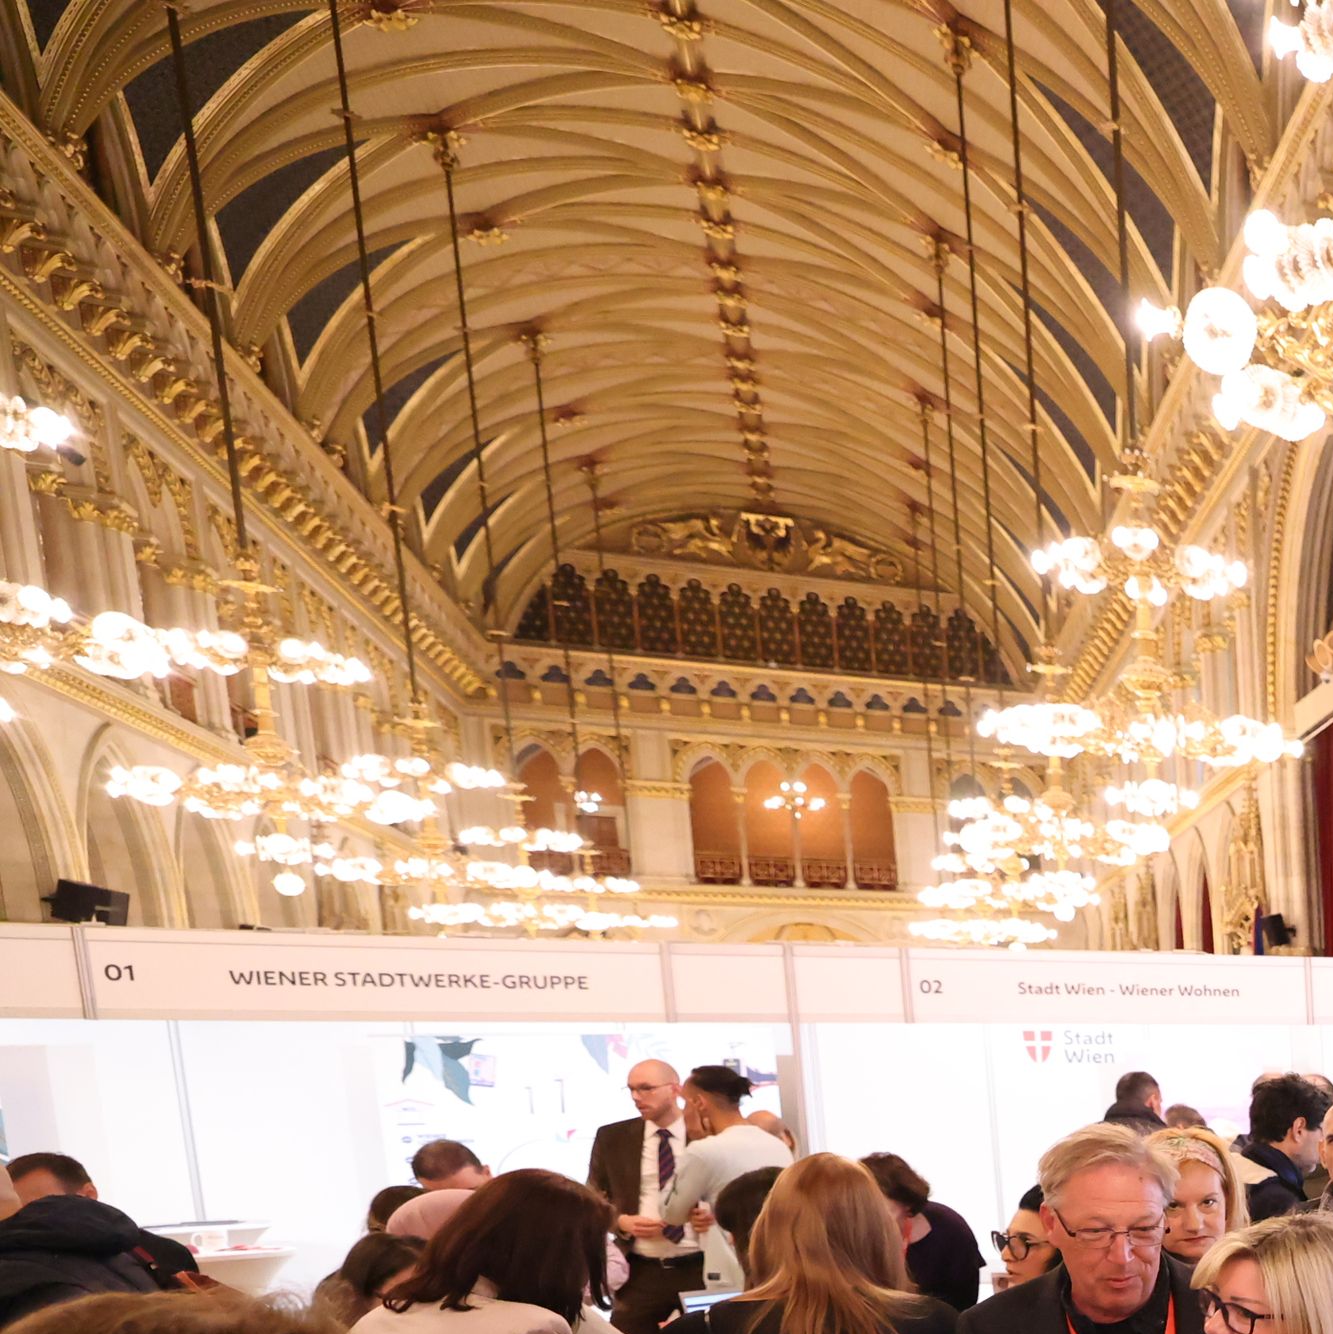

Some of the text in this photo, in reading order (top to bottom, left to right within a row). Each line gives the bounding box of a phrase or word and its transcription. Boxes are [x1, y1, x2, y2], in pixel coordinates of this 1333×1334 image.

[104, 963, 136, 982] 01
[229, 970, 590, 990] WIENER STADTWERKE-GRUPPE
[919, 979, 944, 994] 02
[1017, 981, 1060, 996] Stadt
[1064, 982, 1105, 996] Wien
[1118, 983, 1173, 997] Wiener
[1177, 984, 1241, 998] Wohnen
[1064, 1030, 1114, 1046] Stadt
[1064, 1049, 1116, 1064] Wien
